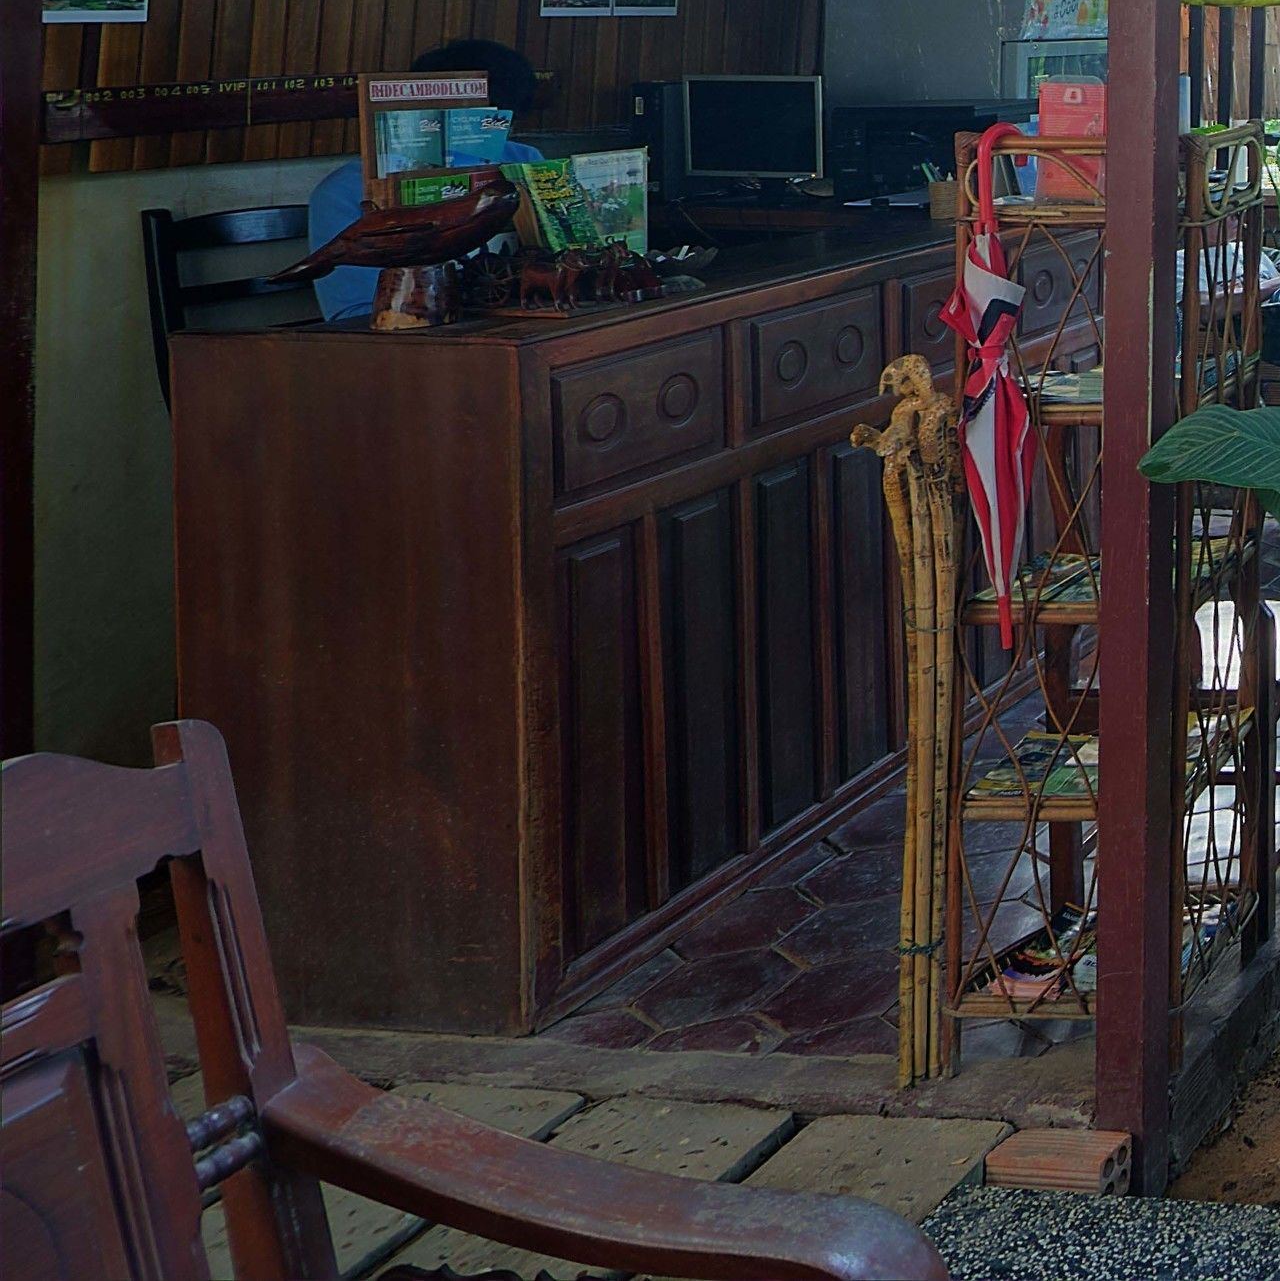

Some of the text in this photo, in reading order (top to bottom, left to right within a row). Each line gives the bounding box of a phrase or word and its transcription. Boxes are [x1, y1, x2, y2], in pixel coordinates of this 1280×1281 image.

[120, 87, 145, 100] 003
[154, 85, 181, 97] 004
[284, 78, 305, 90] 102
[313, 77, 335, 89] 103
[371, 82, 487, 98] RIDECAMBODIA.COM
[480, 118, 510, 130] Ride
[440, 185, 469, 197] Ride
